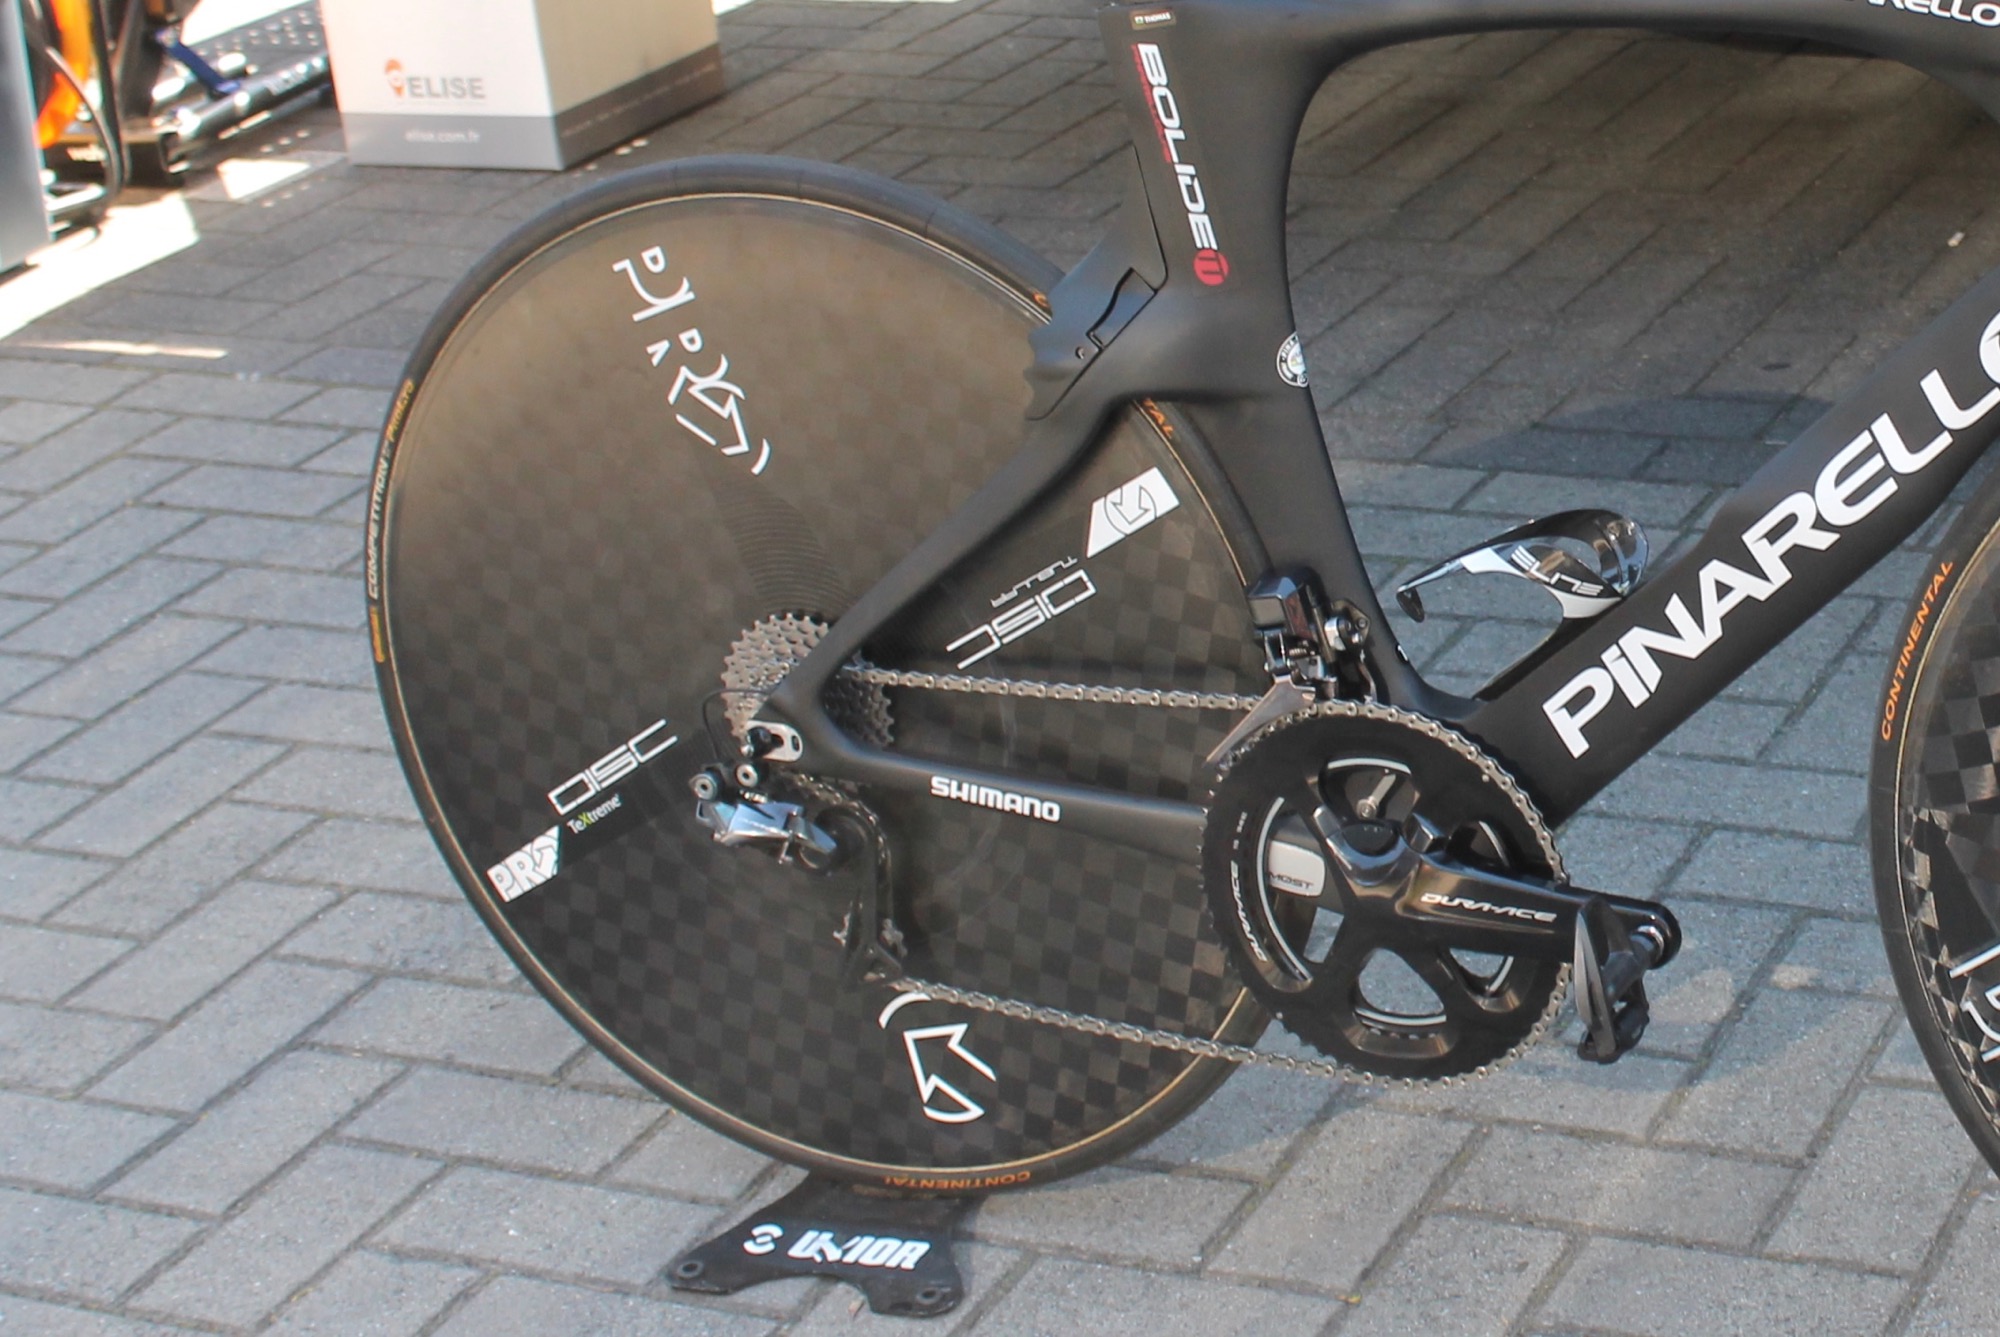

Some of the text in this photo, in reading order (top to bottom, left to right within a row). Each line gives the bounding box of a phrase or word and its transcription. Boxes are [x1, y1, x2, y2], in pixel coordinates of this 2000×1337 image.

[406, 76, 486, 99] ELISE
[1137, 42, 1218, 250] BOLIDE
[367, 458, 389, 600] COMPETITION
[946, 569, 1097, 670] DISC
[1880, 560, 1954, 741] CONTINENTAL
[547, 718, 678, 816] DISC
[930, 776, 1062, 823] SHIMANO
[566, 793, 623, 834] TeXtreme
[1269, 871, 1314, 889] MOST
[1420, 892, 1557, 923] DURA-ACE
